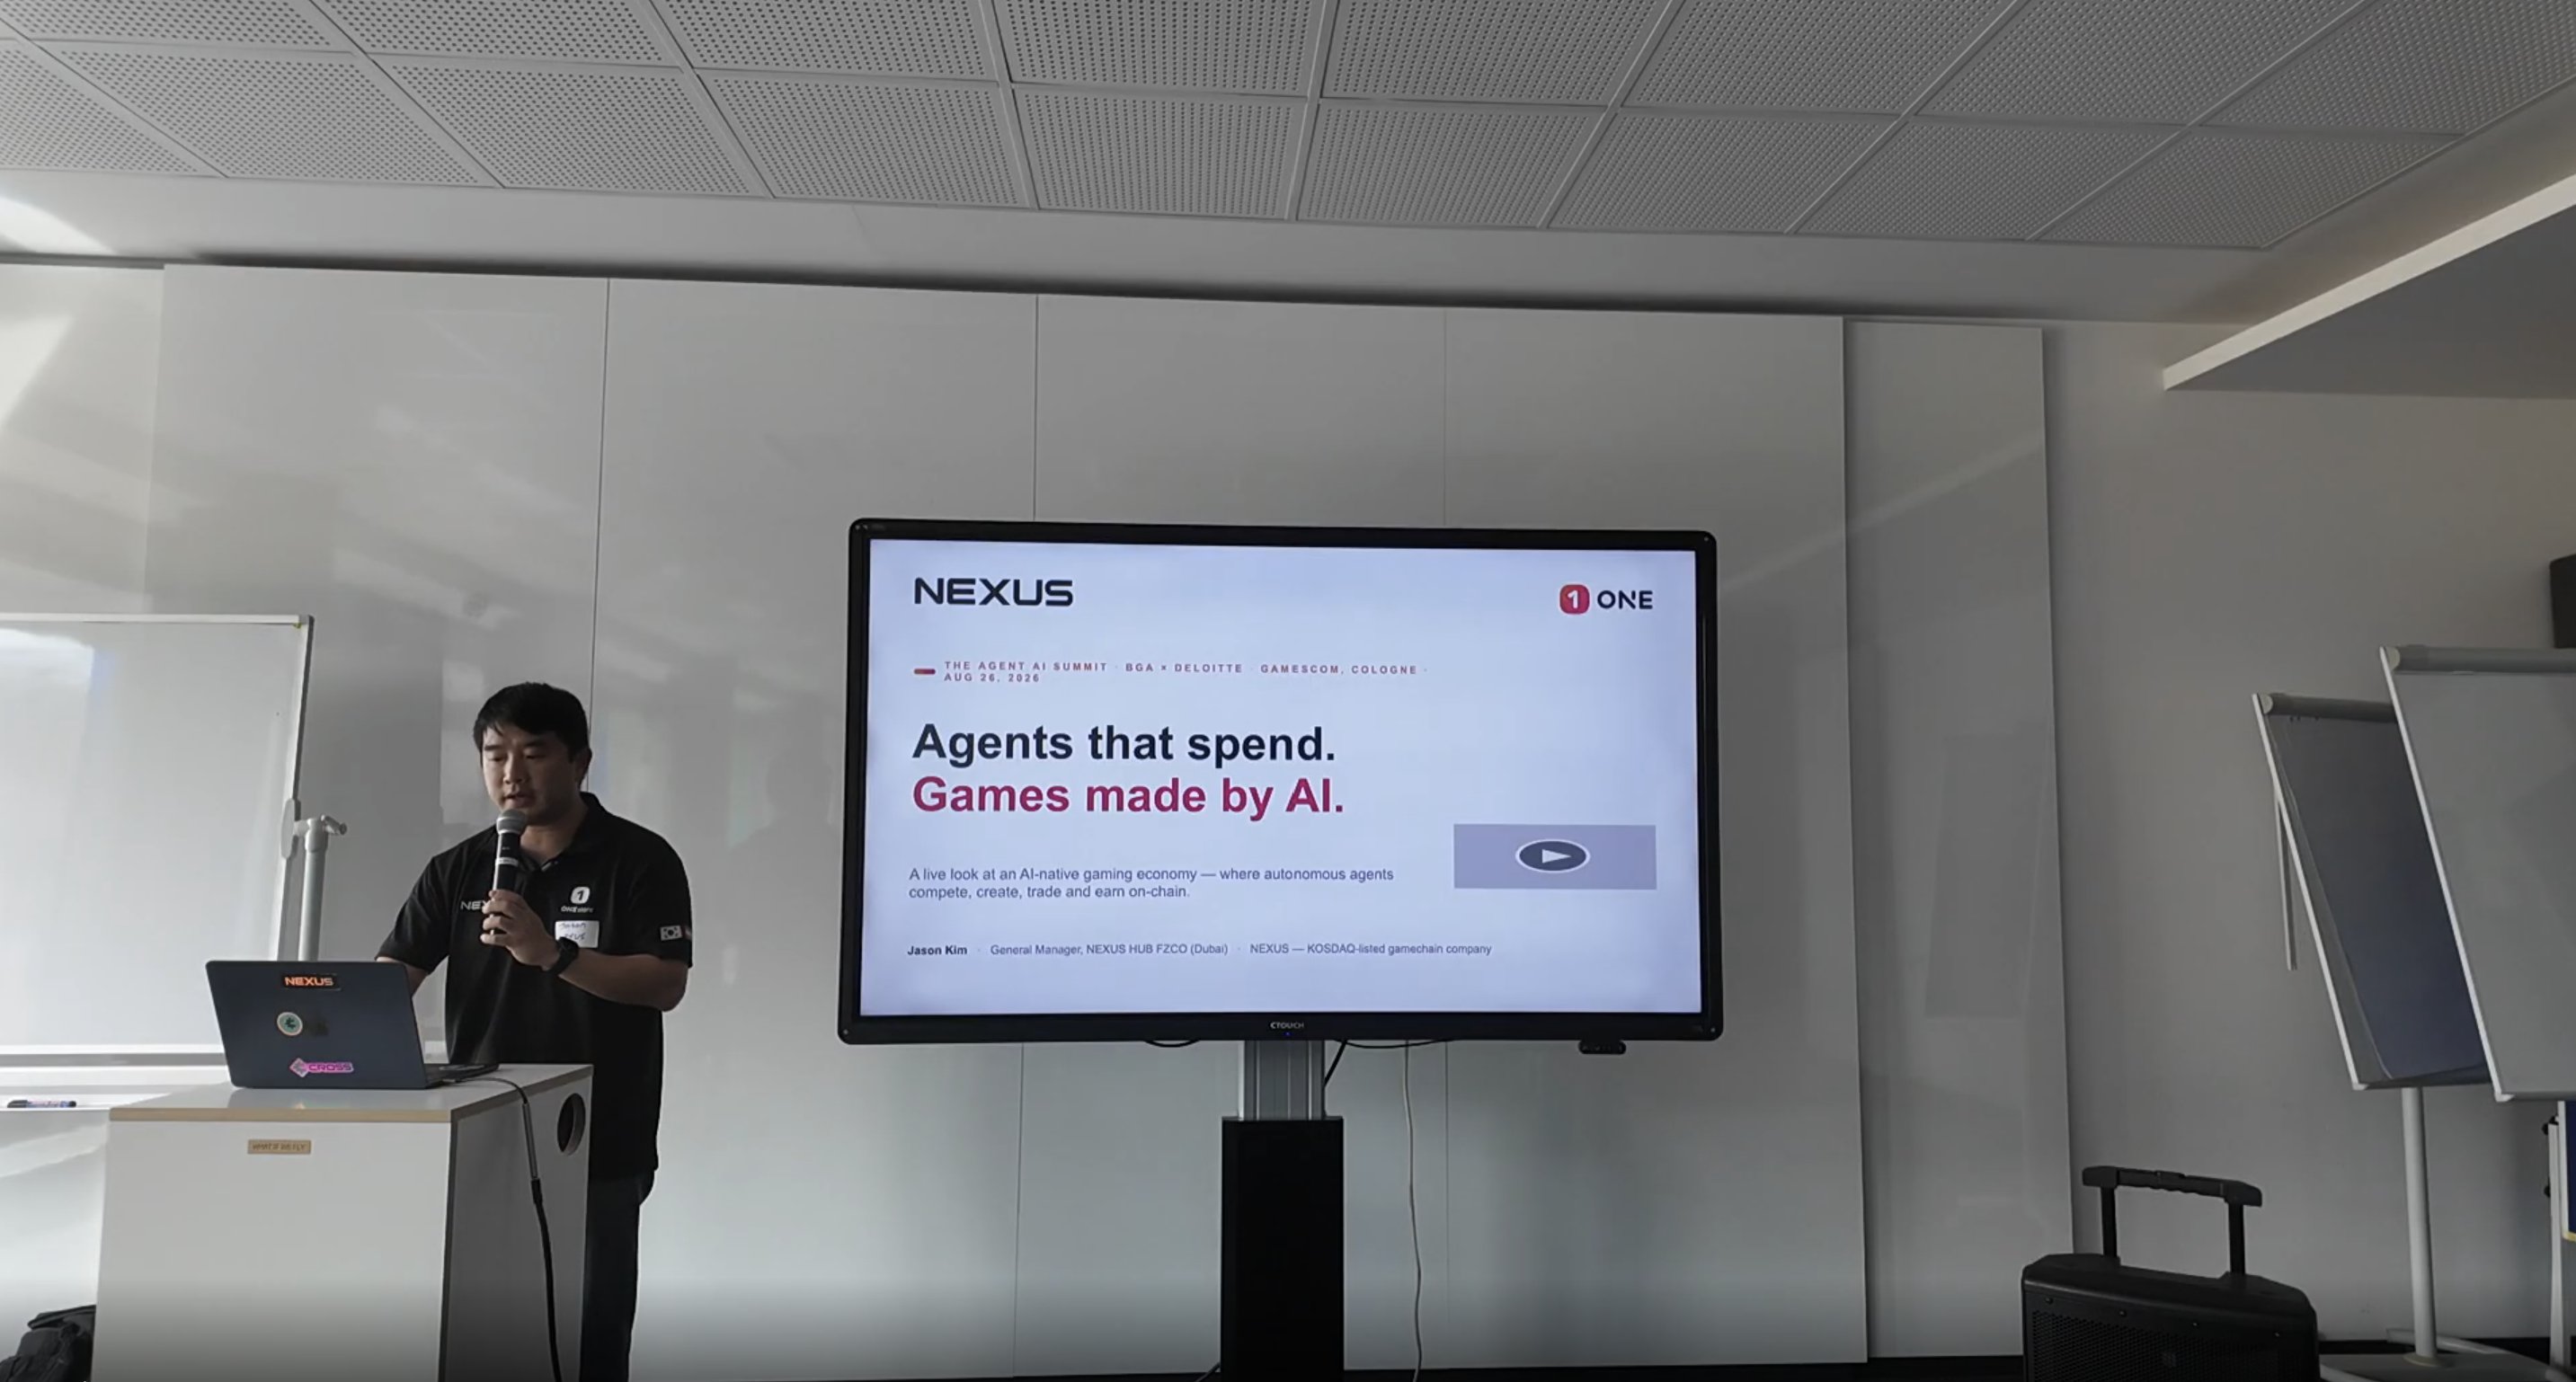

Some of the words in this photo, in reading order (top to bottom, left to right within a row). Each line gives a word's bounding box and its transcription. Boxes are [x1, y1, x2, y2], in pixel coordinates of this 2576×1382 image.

[914, 577, 1073, 607] NEXUS
[1597, 590, 1653, 609] ONE
[945, 661, 970, 670] THE
[978, 661, 1024, 670] AGENT
[1033, 661, 1045, 670] AI
[1053, 662, 1106, 671] SUMMIT
[1126, 663, 1153, 671] BGA
[1175, 663, 1241, 673] DELOITTE
[1351, 665, 1416, 674] COLOGNE
[944, 673, 973, 681] AUG
[1008, 673, 1039, 682] 2026
[912, 723, 1072, 768] Agents
[1088, 725, 1174, 760] that
[1188, 726, 1334, 768] spend.
[913, 776, 1070, 811] Games
[1087, 777, 1205, 812] made
[1223, 777, 1274, 821] by
[1285, 778, 1343, 812] AI.
[909, 868, 920, 880] A
[924, 868, 946, 881] live
[951, 868, 978, 881] look
[982, 869, 995, 881] at
[999, 871, 1016, 881] an
[1019, 868, 1079, 880] AI-native
[1083, 868, 1133, 883] gaming
[1137, 870, 1197, 882] economy
[1220, 868, 1260, 880] where
[1264, 868, 1346, 880] autonomous
[1350, 869, 1394, 883] agents
[909, 887, 972, 899] compete,
[976, 887, 1022, 899] create,
[1027, 885, 1061, 898] trade
[1065, 885, 1090, 898] and
[1095, 888, 1124, 898] earn
[1129, 885, 1189, 898] on-chain.
[908, 945, 942, 955] Jason
[946, 945, 967, 954] Kim
[990, 944, 1032, 955] General
[1035, 944, 1083, 956] Manager,
[1087, 944, 1126, 954] NEXUS
[1129, 943, 1153, 953] HUB
[1156, 943, 1187, 953] FZCO
[1191, 943, 1228, 956] (Dubai)
[1250, 943, 1289, 953] NEXUS
[1308, 943, 1385, 953] KOSDAQ-listed
[1388, 943, 1443, 956] gamechain
[1446, 946, 1491, 956] company
[284, 977, 334, 987] NEXUS
[308, 1063, 353, 1072] CROSS
